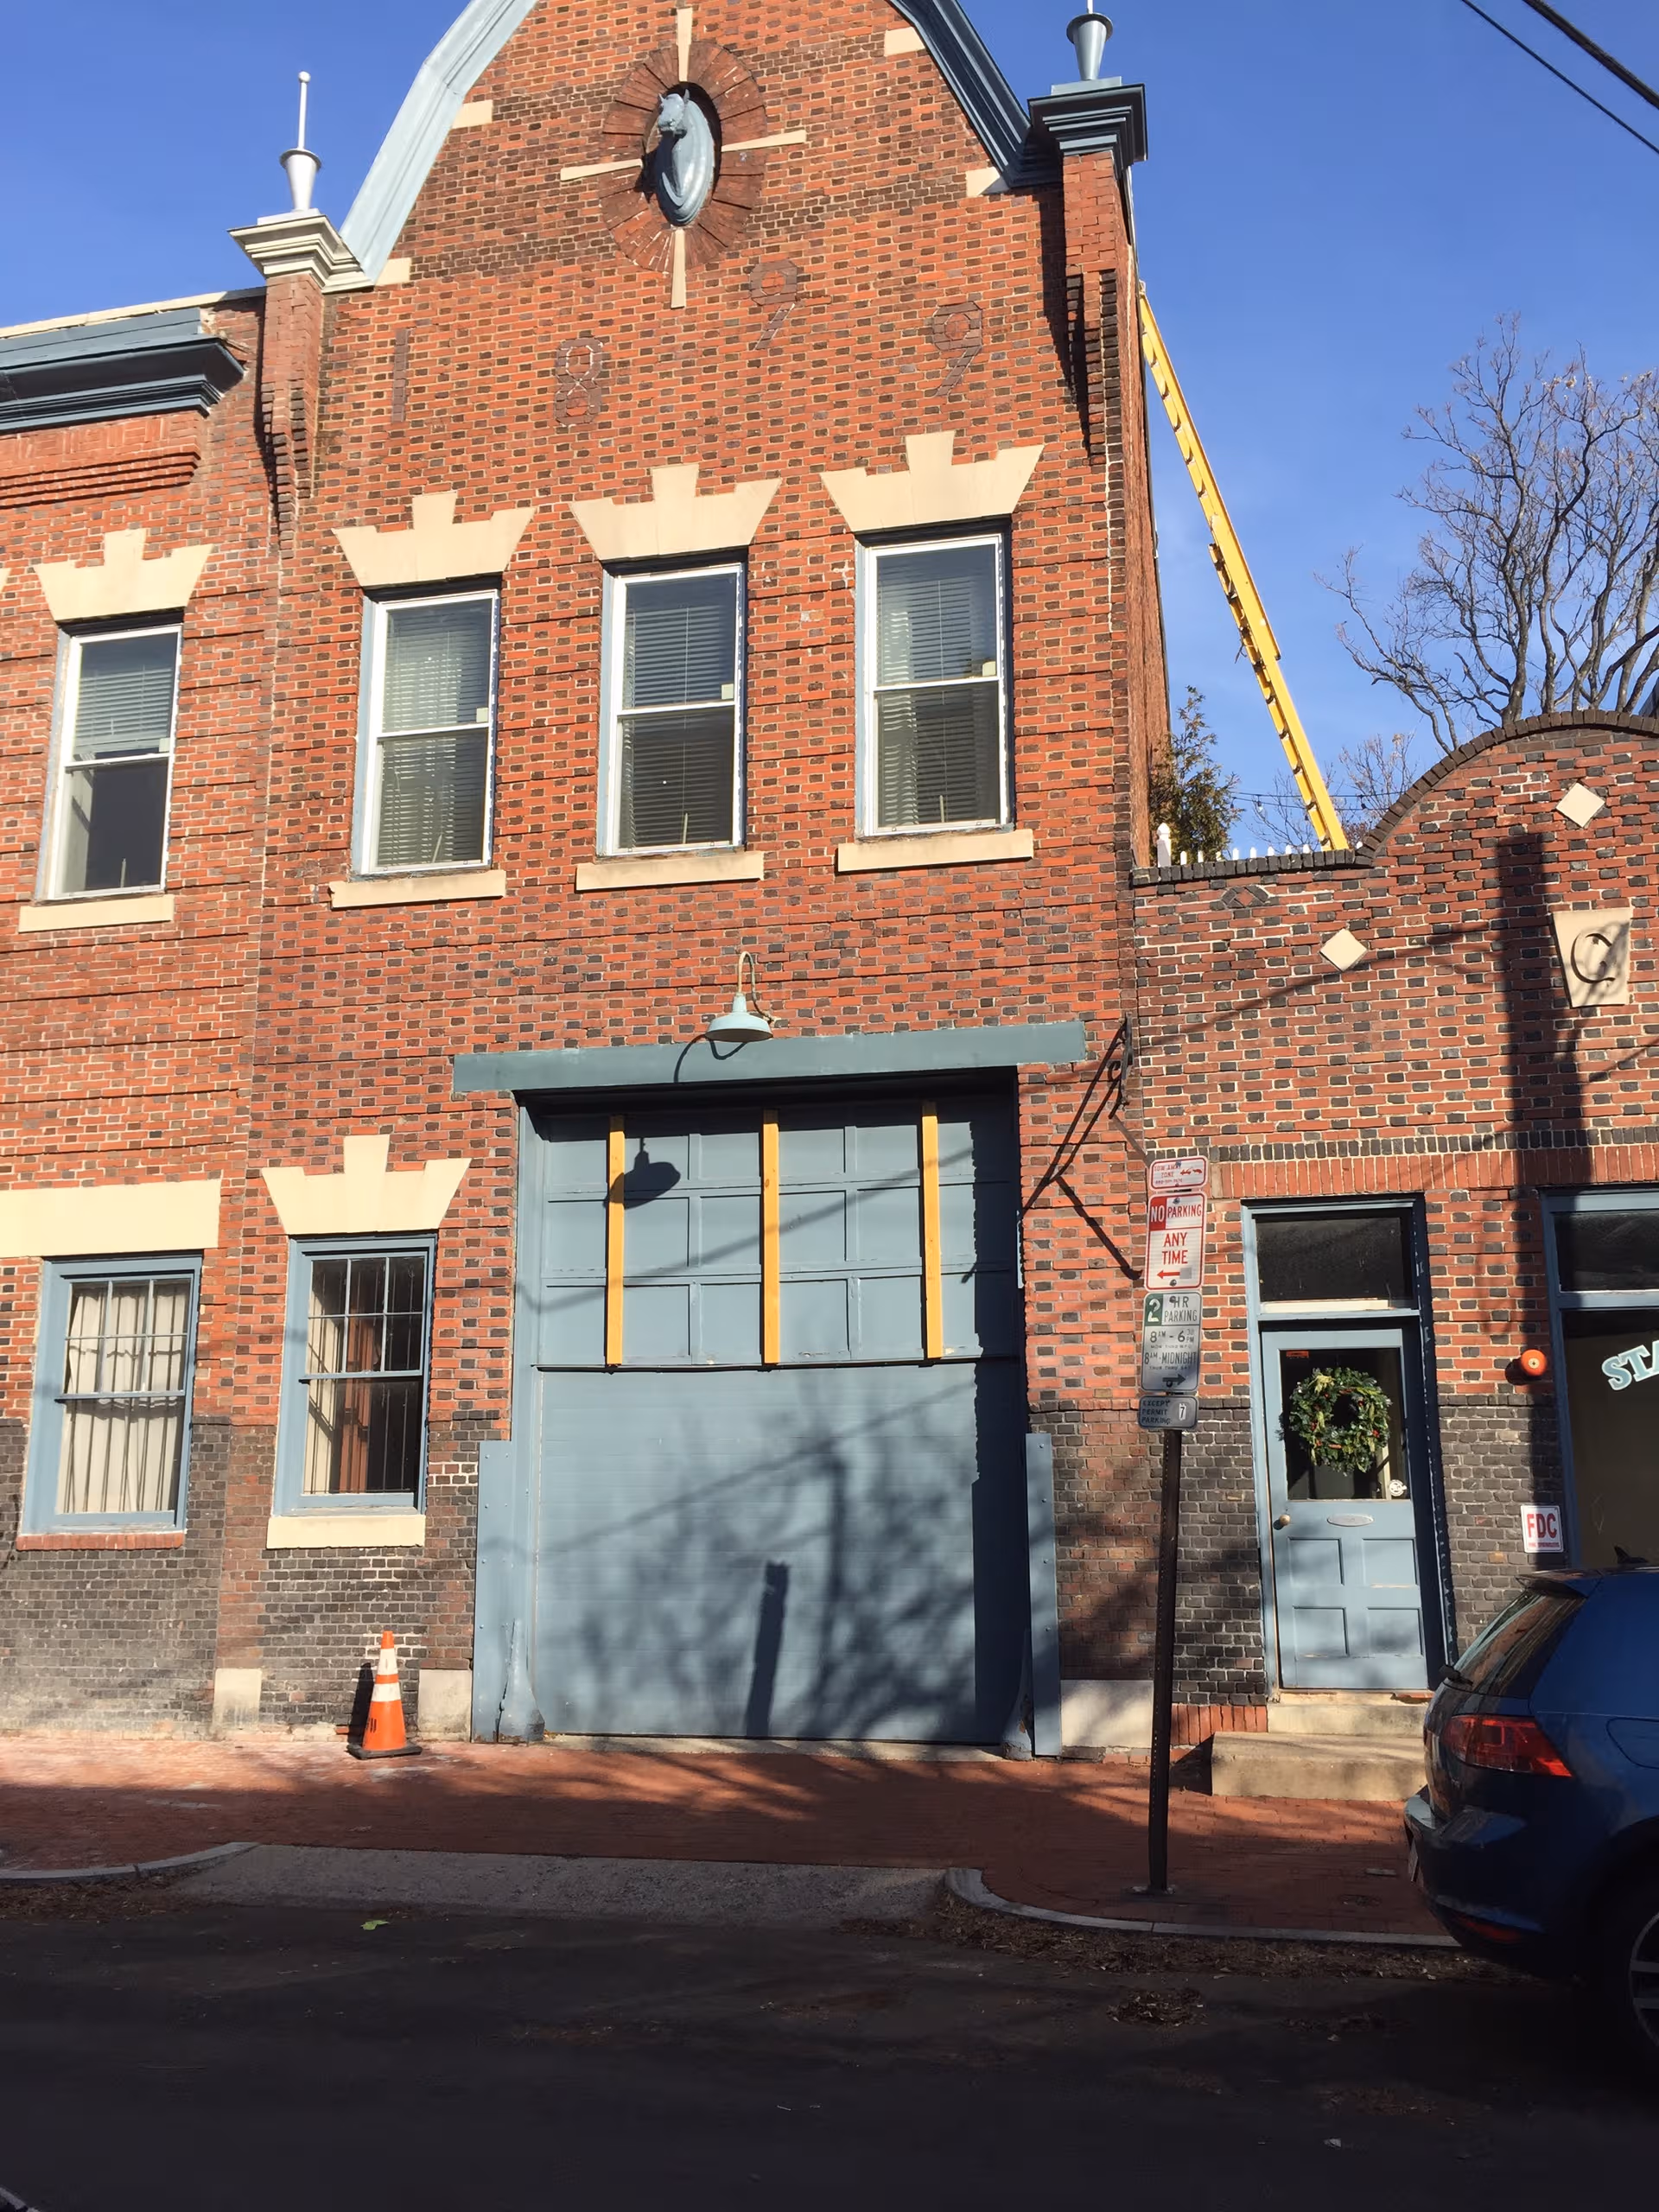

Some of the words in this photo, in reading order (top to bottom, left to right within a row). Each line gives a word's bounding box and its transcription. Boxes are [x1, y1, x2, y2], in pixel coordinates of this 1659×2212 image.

[1151, 1205, 1165, 1223] NO
[1167, 1204, 1202, 1218] PARKING
[1163, 1232, 1187, 1247] ANY
[1162, 1249, 1188, 1265] TIME
[1147, 1298, 1161, 1323] 2
[1173, 1295, 1190, 1308] HR
[1164, 1309, 1198, 1323] PARKING
[1601, 1339, 1659, 1390] ST
[1141, 1416, 1171, 1425] PARKING
[1526, 1513, 1557, 1538] FDC
